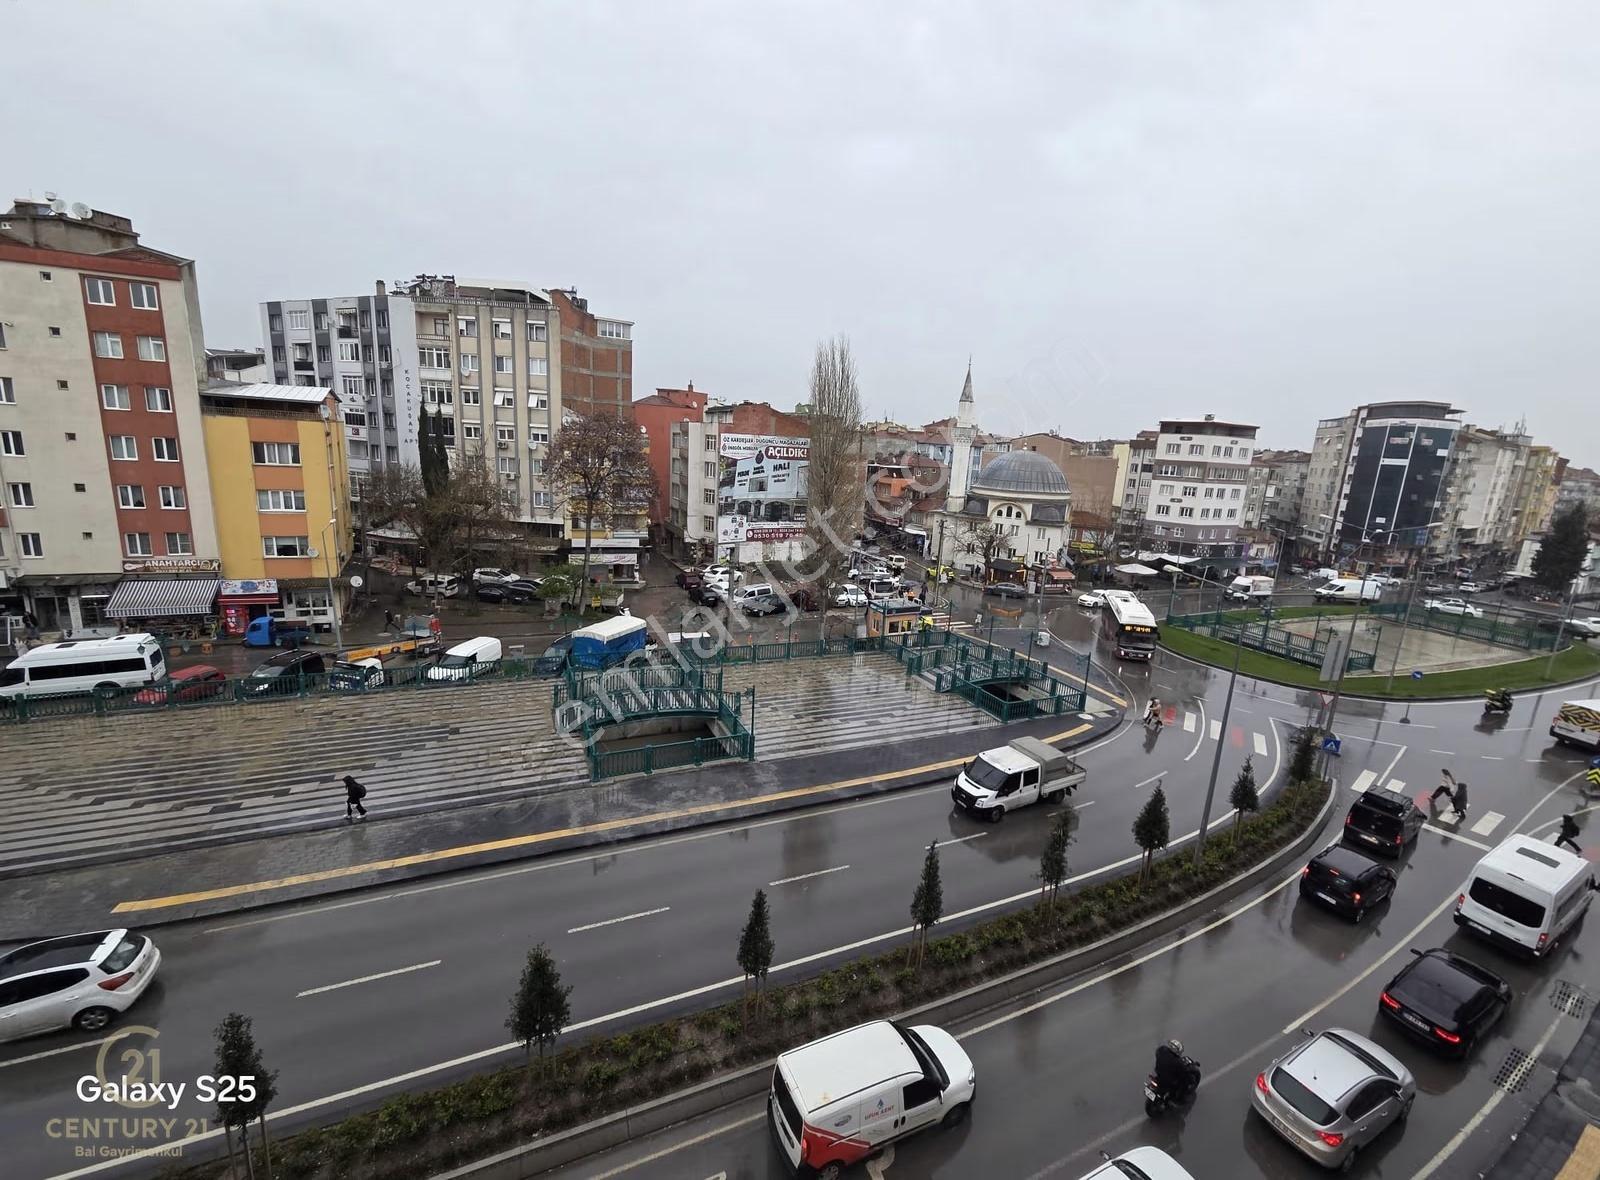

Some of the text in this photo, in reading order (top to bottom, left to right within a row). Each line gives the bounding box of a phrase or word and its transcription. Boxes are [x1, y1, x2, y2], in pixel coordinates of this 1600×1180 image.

[768, 446, 807, 459] AÇILDIK!
[773, 462, 790, 472] HALI
[145, 559, 200, 567] ANAHTARCI
